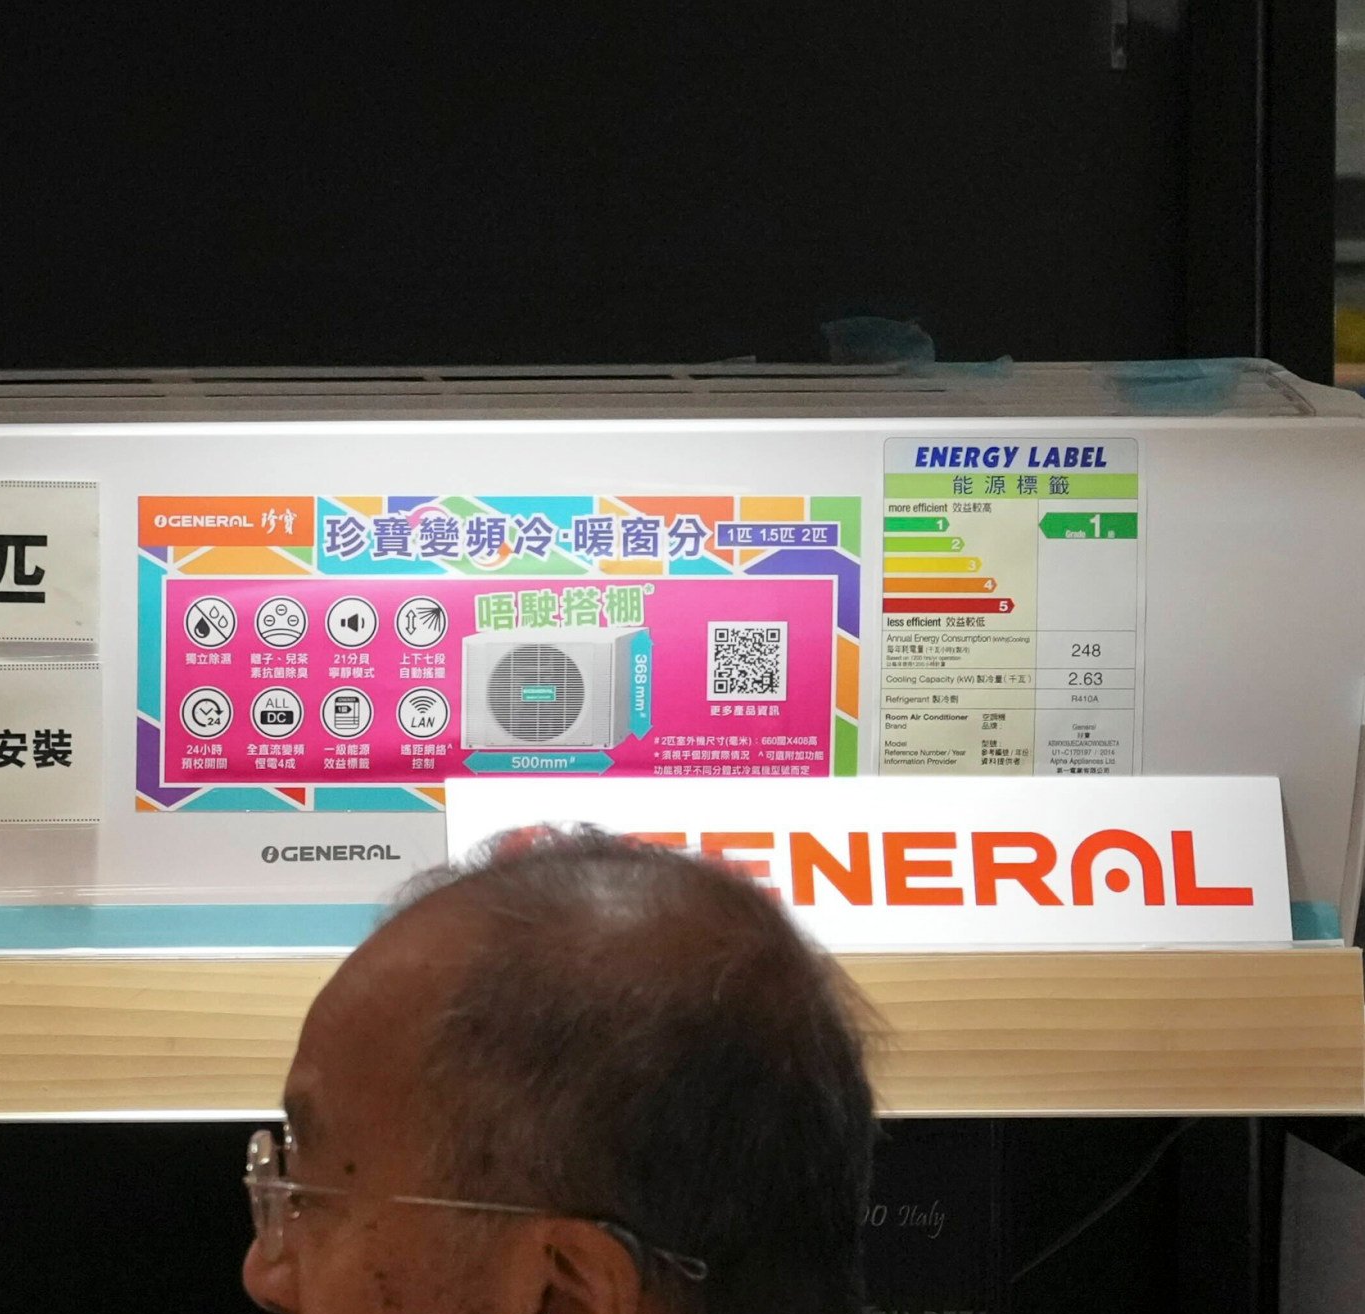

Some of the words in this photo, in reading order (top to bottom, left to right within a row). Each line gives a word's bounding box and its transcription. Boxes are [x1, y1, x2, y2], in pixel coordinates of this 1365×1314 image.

[915, 446, 1020, 468] ENERGY
[1028, 446, 1107, 468] LABEL
[953, 475, 1070, 495] 能源標籤
[888, 503, 911, 512] more
[912, 503, 948, 513] efficient
[952, 502, 992, 513] 效益較高
[169, 515, 254, 528] GENERAL
[727, 529, 753, 542] 1匹
[760, 529, 795, 542] 1.5匹
[802, 529, 828, 542] 2匹
[887, 617, 905, 627] less
[906, 617, 941, 627] efficient
[946, 617, 985, 627] 效益較低
[1072, 644, 1101, 657] 248
[185, 654, 232, 664] 獨立除濕
[333, 654, 369, 665] 21分貝
[399, 654, 446, 665] 上下七段
[250, 667, 308, 679] 素抗菌除臭
[328, 667, 374, 679] 寧靜模式
[399, 667, 446, 679] 自動搖擺
[1068, 673, 1103, 686] 2.63
[266, 698, 289, 709] ALL
[710, 705, 780, 717] 更多產品資訊
[207, 718, 221, 726] 24
[267, 712, 286, 723] DC
[410, 717, 435, 728] LAN
[186, 744, 223, 755] 24小時
[246, 744, 305, 755] 全直流變頻
[324, 744, 370, 755] 一級能源
[182, 758, 228, 769] 預校開關
[255, 758, 296, 769] 慳電4成
[323, 758, 370, 769] 效益標籤
[412, 758, 434, 769] 控制
[281, 843, 401, 862] GENERAL
[617, 829, 1253, 907] ENERAL
